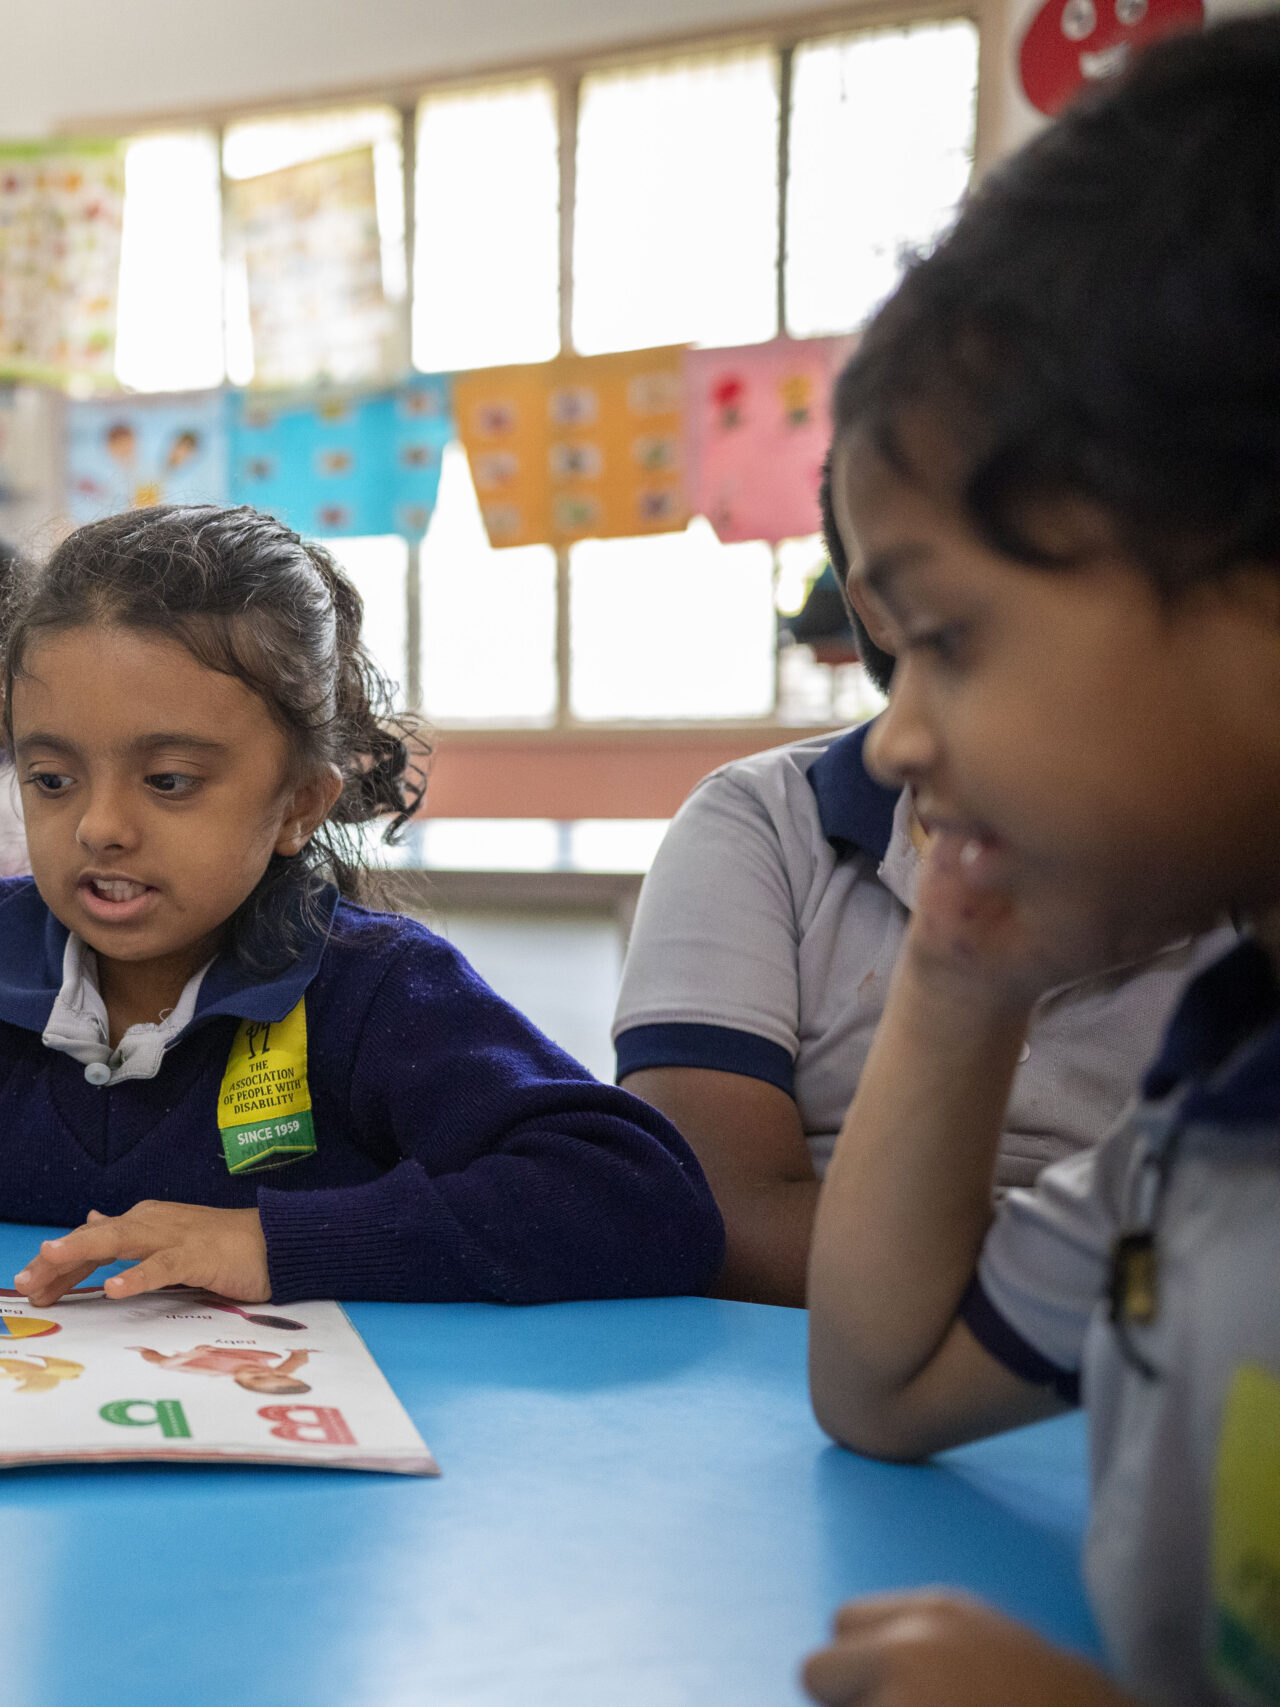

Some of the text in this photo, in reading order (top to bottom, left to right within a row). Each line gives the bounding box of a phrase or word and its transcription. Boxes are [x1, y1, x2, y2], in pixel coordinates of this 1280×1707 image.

[249, 1060, 269, 1073] THE
[223, 1079, 302, 1105] OF PEOPLE WITH
[228, 1067, 295, 1092] ASSOCIATION
[233, 1093, 295, 1114] DISABILITY
[237, 1120, 300, 1145] SINCE 1959
[256, 1403, 358, 1446] B
